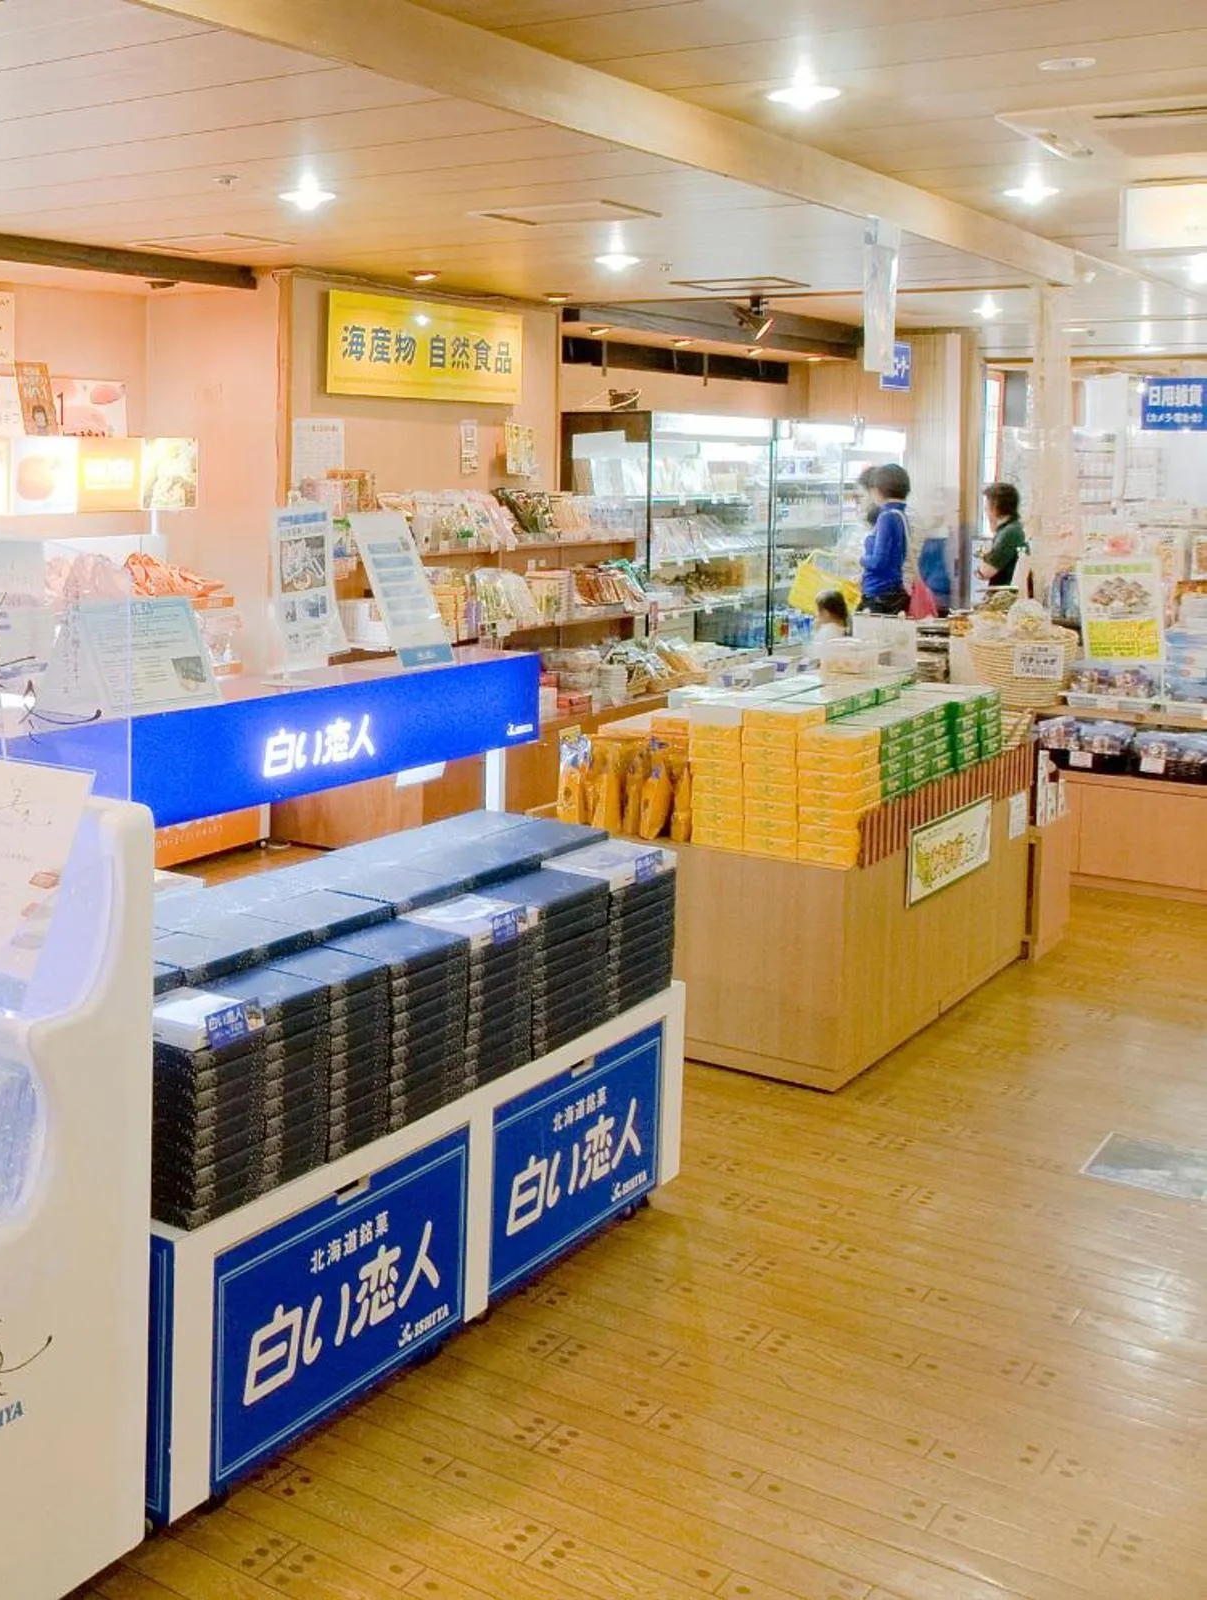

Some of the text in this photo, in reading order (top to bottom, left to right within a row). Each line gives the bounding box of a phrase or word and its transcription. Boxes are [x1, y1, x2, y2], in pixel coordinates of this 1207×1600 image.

[341, 324, 513, 375] 海産物 自然食品
[263, 713, 375, 778] 白い恋人
[505, 1097, 642, 1236] 白い恋人
[310, 1210, 390, 1274] 北海道銘菓
[243, 1220, 441, 1406] 白い恋人
